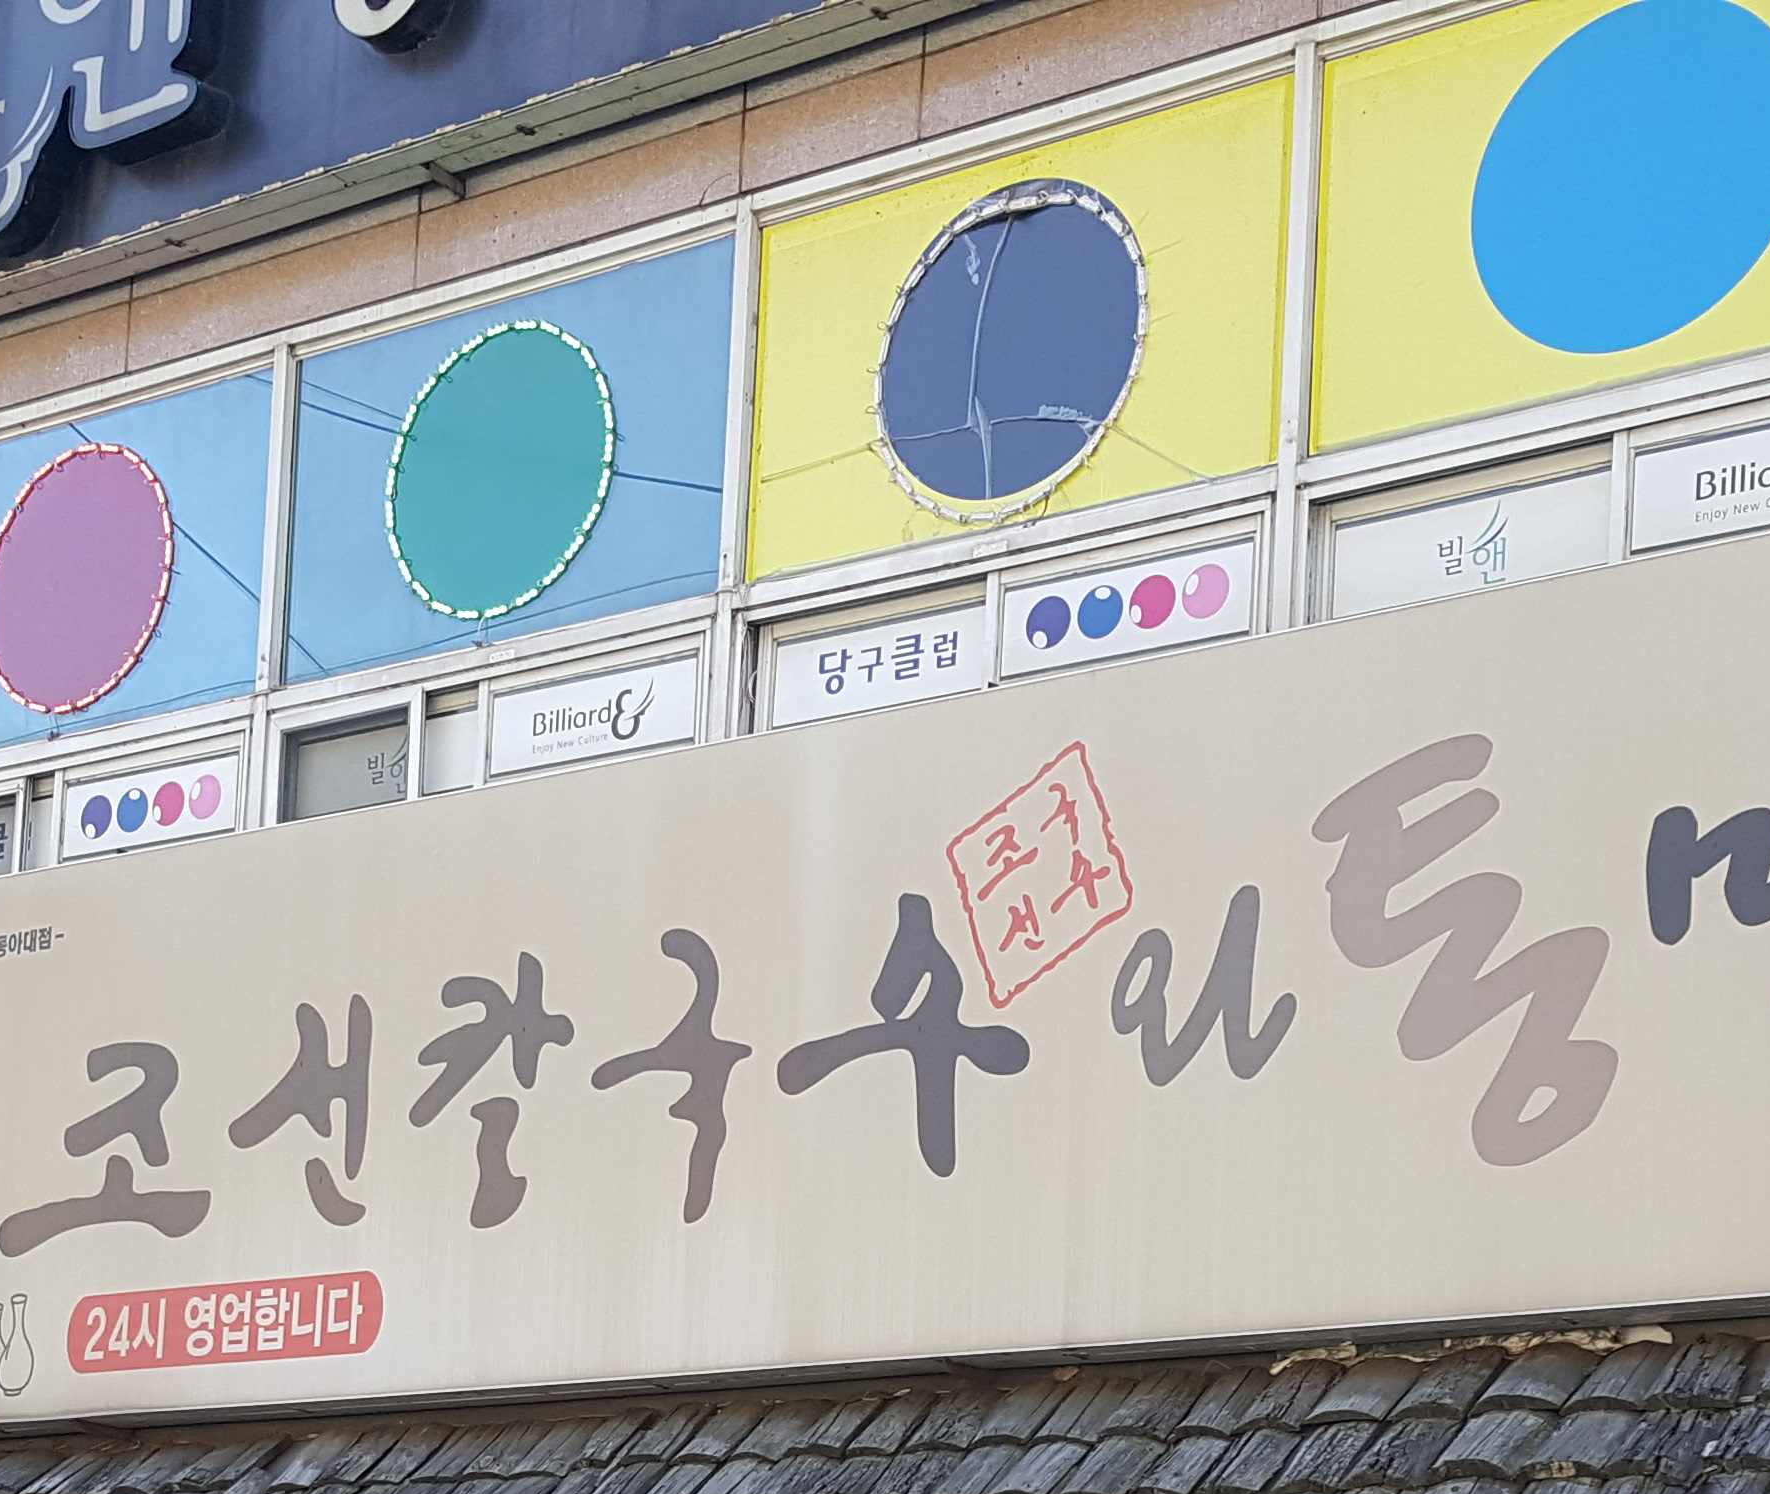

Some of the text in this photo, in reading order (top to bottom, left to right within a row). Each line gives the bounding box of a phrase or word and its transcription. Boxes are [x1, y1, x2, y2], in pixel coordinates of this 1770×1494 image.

[1695, 505, 1729, 523] Enjoy
[1733, 500, 1761, 516] New
[818, 631, 959, 695] 당구클럽
[557, 738, 575, 749] New
[578, 732, 608, 746] Culture
[83, 1280, 363, 1361] 24시 영업합니다
